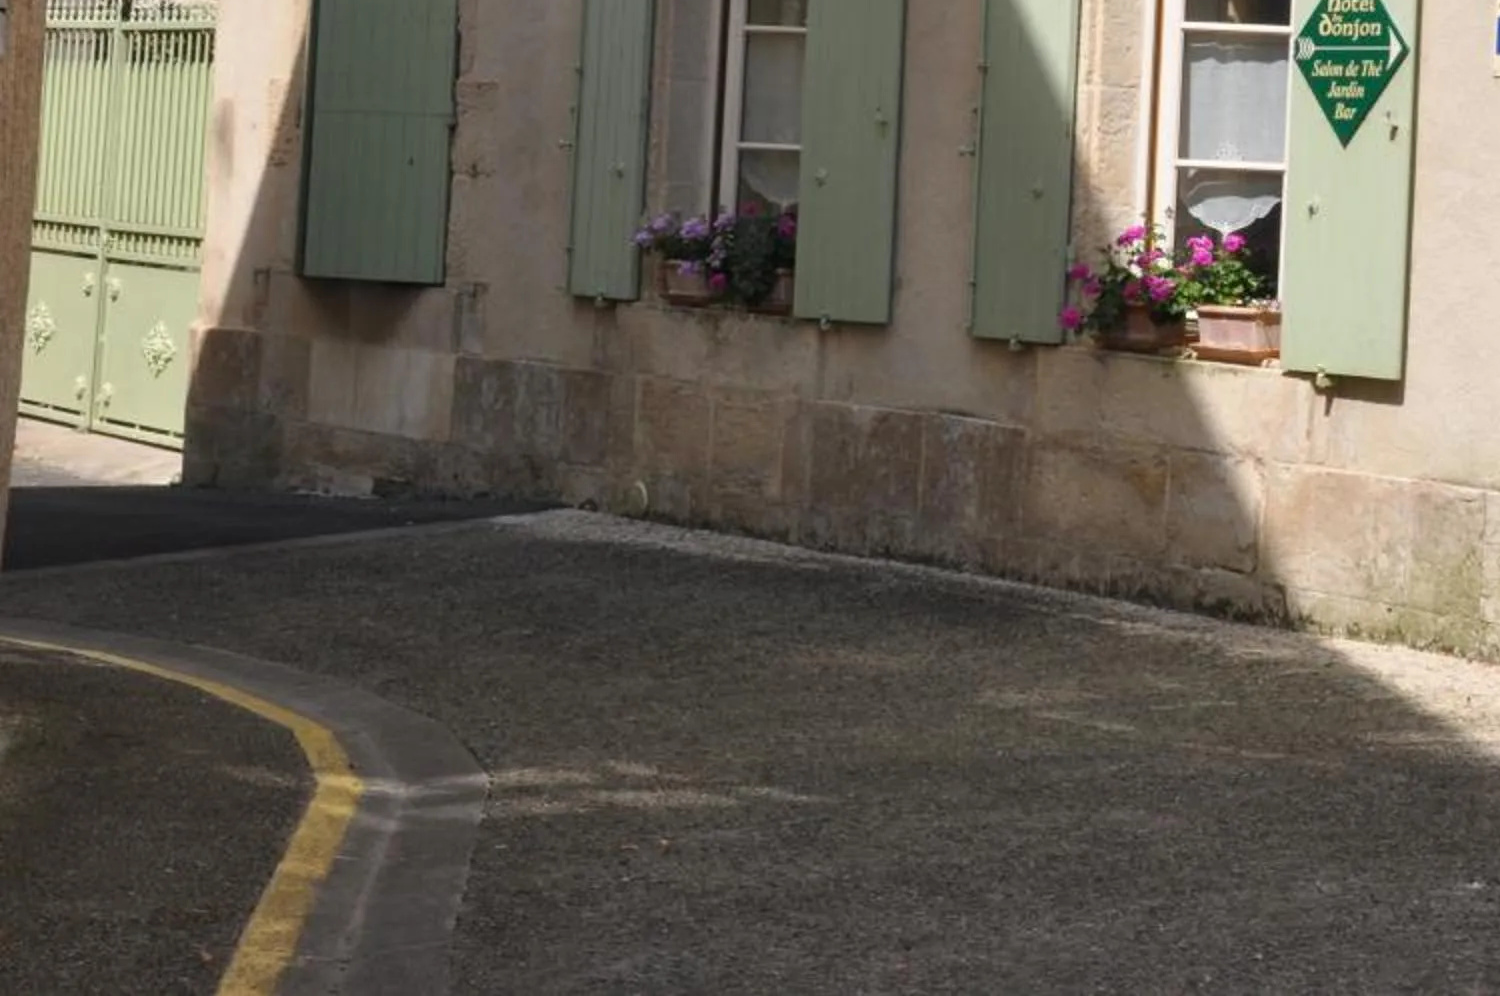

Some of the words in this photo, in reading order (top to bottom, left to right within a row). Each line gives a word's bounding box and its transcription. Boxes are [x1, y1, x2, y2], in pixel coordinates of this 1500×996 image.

[1312, 59, 1343, 77] Salon
[1345, 59, 1360, 77] de
[1327, 81, 1365, 98] Jardin
[1334, 103, 1357, 120] Bar
